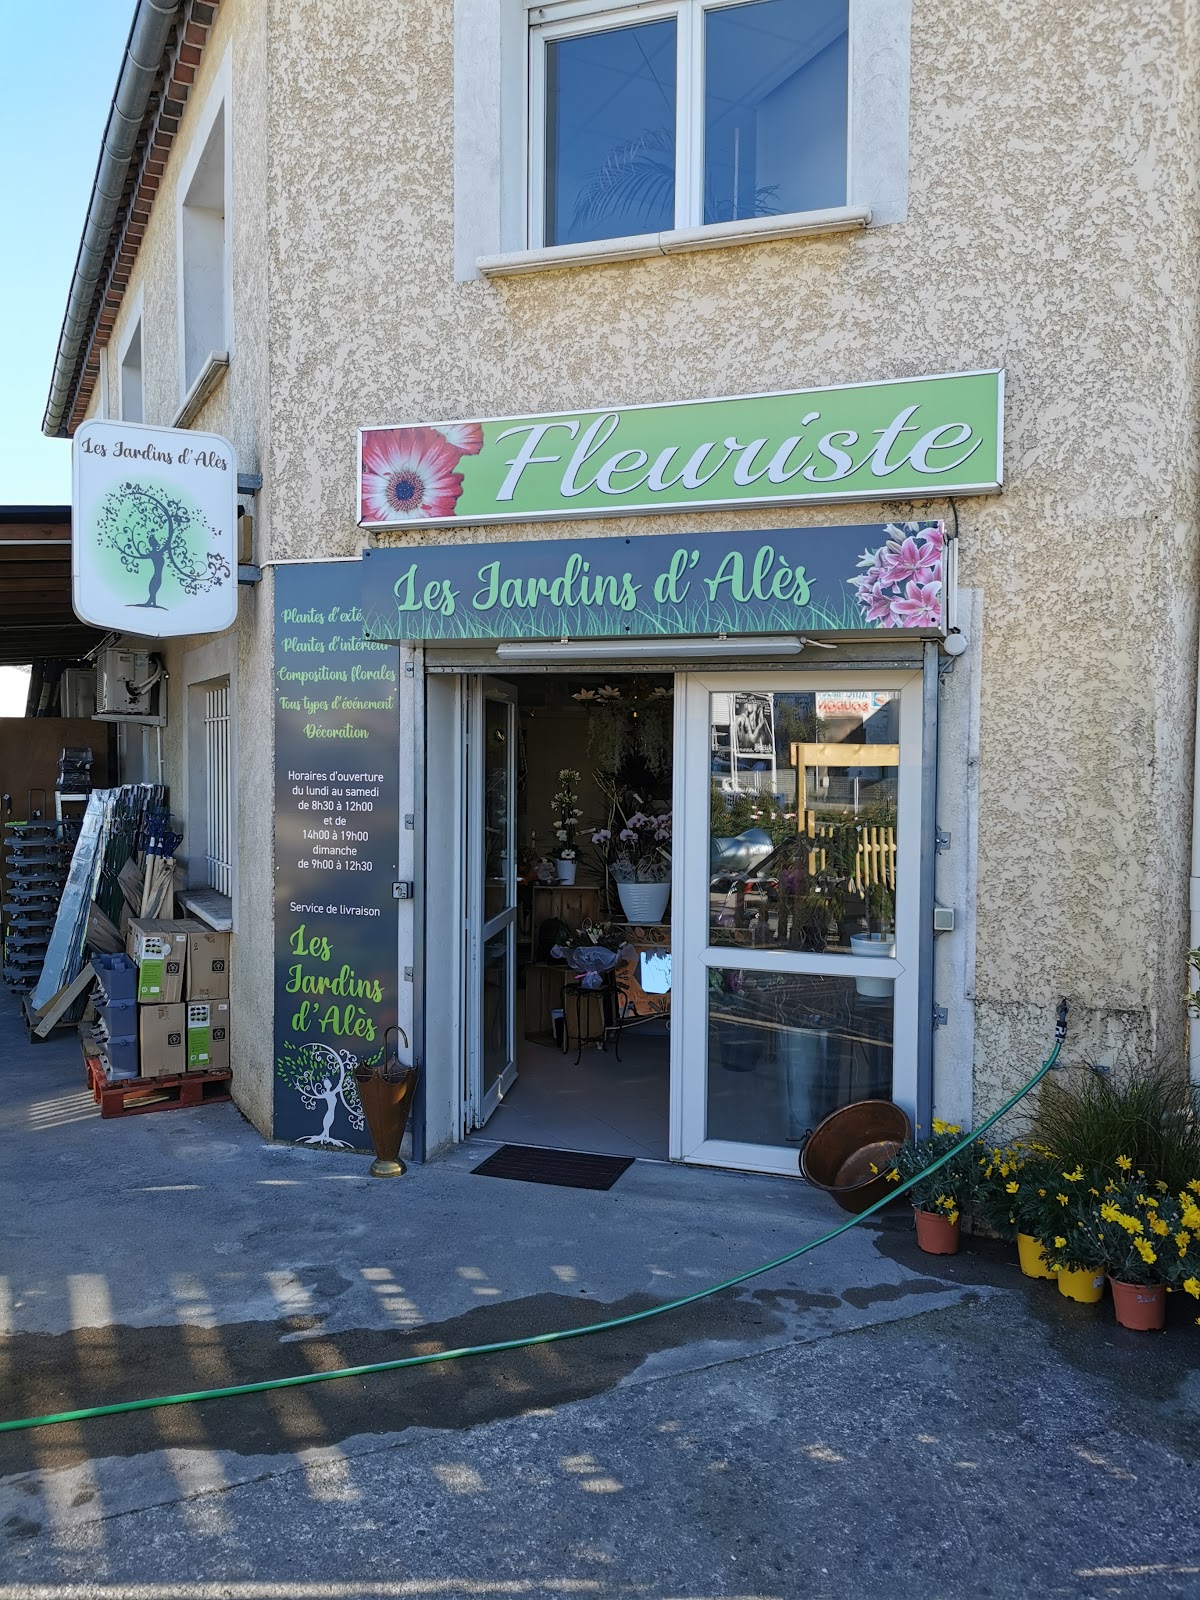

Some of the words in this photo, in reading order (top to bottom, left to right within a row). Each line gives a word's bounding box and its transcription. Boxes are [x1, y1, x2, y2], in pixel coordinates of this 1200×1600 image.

[82, 437, 108, 457] Les
[113, 441, 173, 465] Jardins
[178, 448, 228, 471] d'Alès
[494, 404, 984, 501] Fleuriste
[393, 563, 459, 617] Les
[477, 553, 643, 613] Jardins
[654, 545, 816, 604] d'Alès
[281, 607, 325, 624] Plantes
[328, 606, 362, 623] d'exté
[281, 636, 326, 653] Plantes
[277, 665, 348, 685] Compositions
[351, 664, 397, 682] florales
[279, 696, 302, 711] Tous
[303, 695, 329, 715] types
[331, 695, 394, 710] d'événement
[303, 723, 370, 739] Décoration
[288, 770, 327, 781] Horaires
[329, 771, 384, 782] d'ouverture
[292, 785, 304, 795] du
[306, 786, 329, 796] lundi
[331, 788, 343, 796] au
[345, 787, 379, 797] samedi
[298, 800, 309, 810] de
[311, 801, 334, 811] 8h30
[337, 801, 342, 811] à
[345, 802, 373, 812] 12h00
[323, 816, 333, 826] et
[335, 816, 347, 826] de
[302, 830, 330, 840] 14h00
[332, 831, 338, 840] à
[341, 831, 369, 841] 19h00
[312, 845, 357, 856] dimanche
[298, 859, 309, 868] de
[311, 860, 334, 870] 9h00
[336, 860, 342, 870] à
[345, 861, 373, 871] 12h30
[290, 902, 324, 914] Service
[326, 904, 337, 914] de
[340, 904, 381, 916] livraison
[289, 924, 334, 961] Les
[285, 964, 385, 1003] Jardins
[291, 1001, 378, 1042] d'Alès
